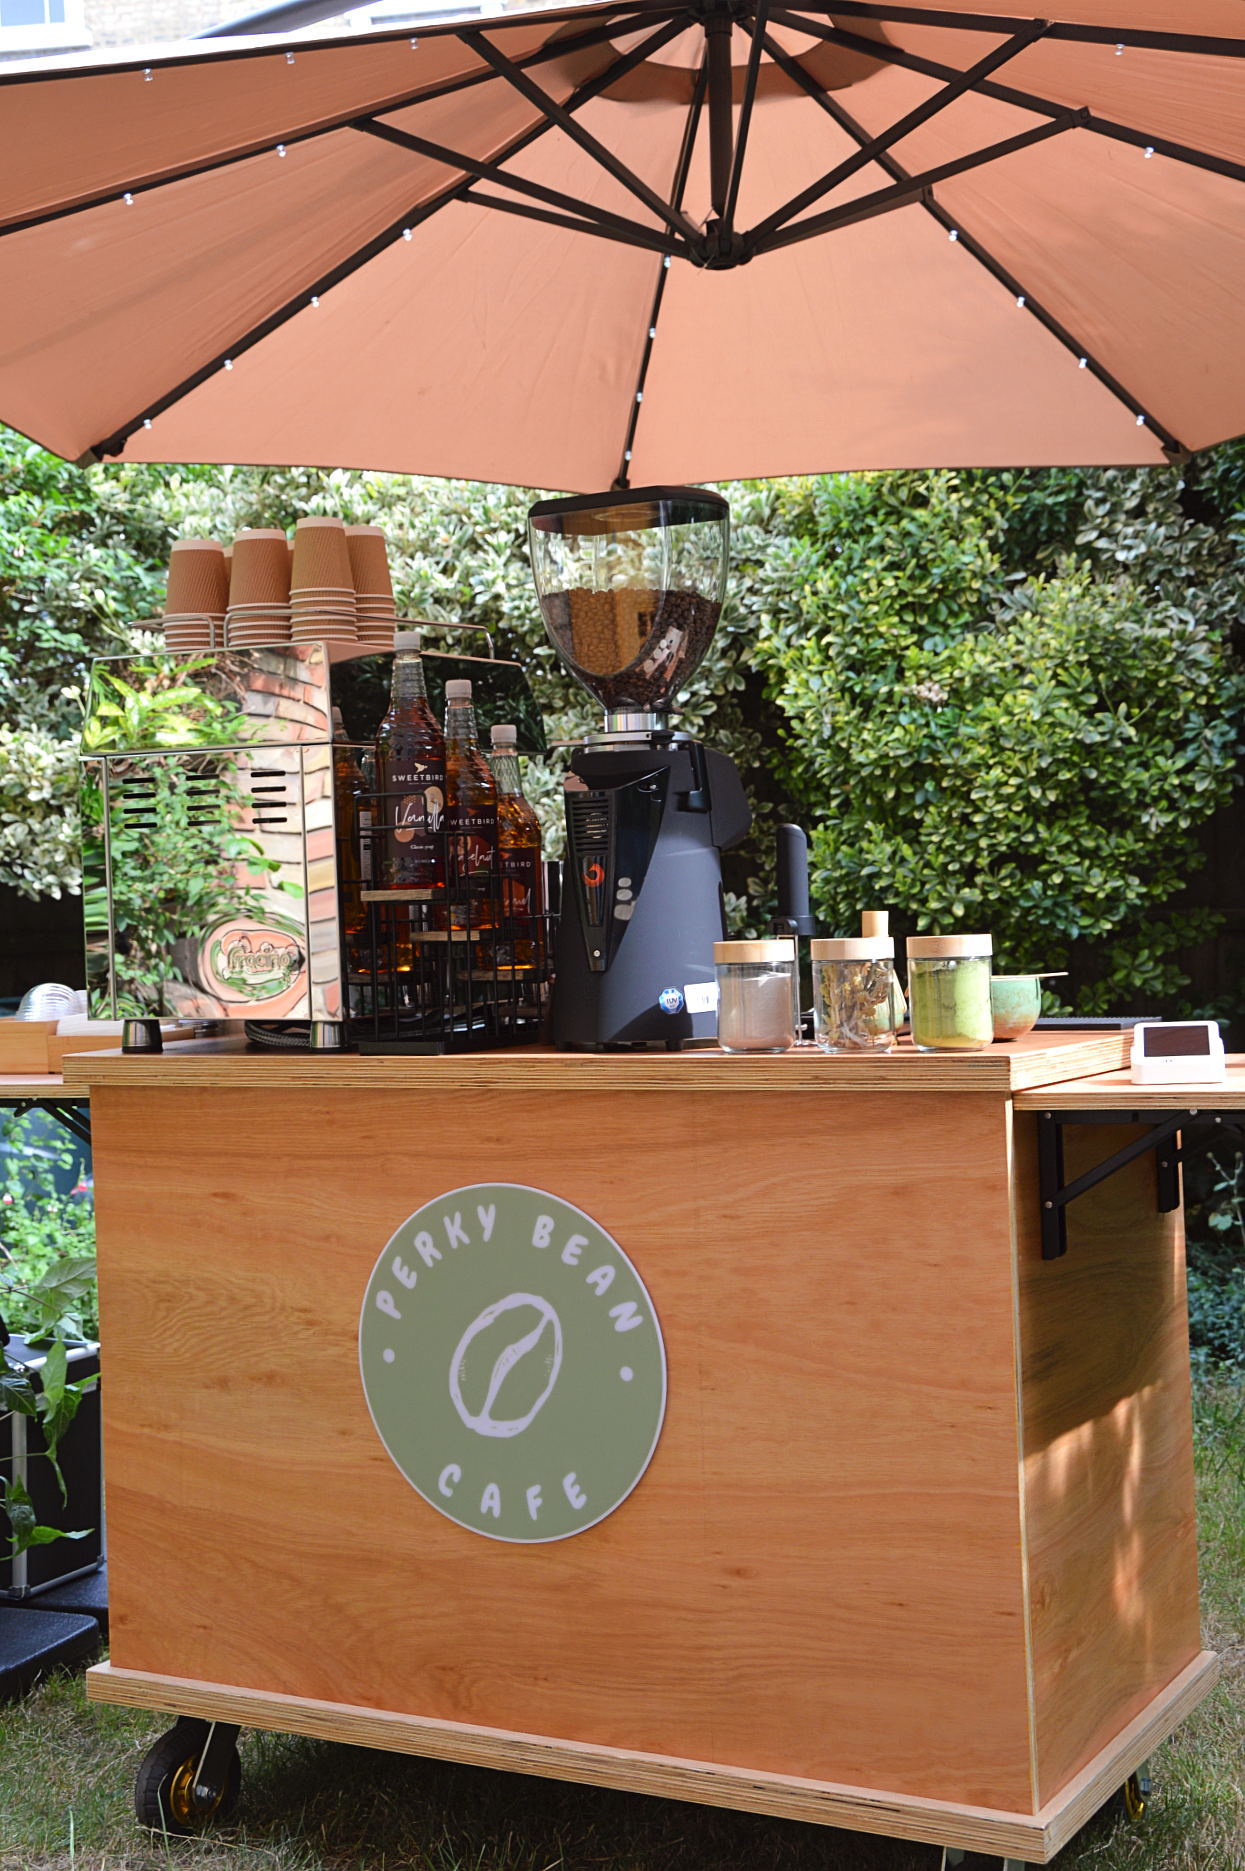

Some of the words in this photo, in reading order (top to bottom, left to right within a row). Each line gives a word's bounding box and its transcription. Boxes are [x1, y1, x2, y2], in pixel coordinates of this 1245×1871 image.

[392, 774, 444, 782] SWEETBIRD
[449, 818, 495, 826] WEETBIRD
[375, 1203, 496, 1320] PERKY
[532, 1215, 643, 1332] BEAN
[438, 1463, 587, 1520] CAFE
